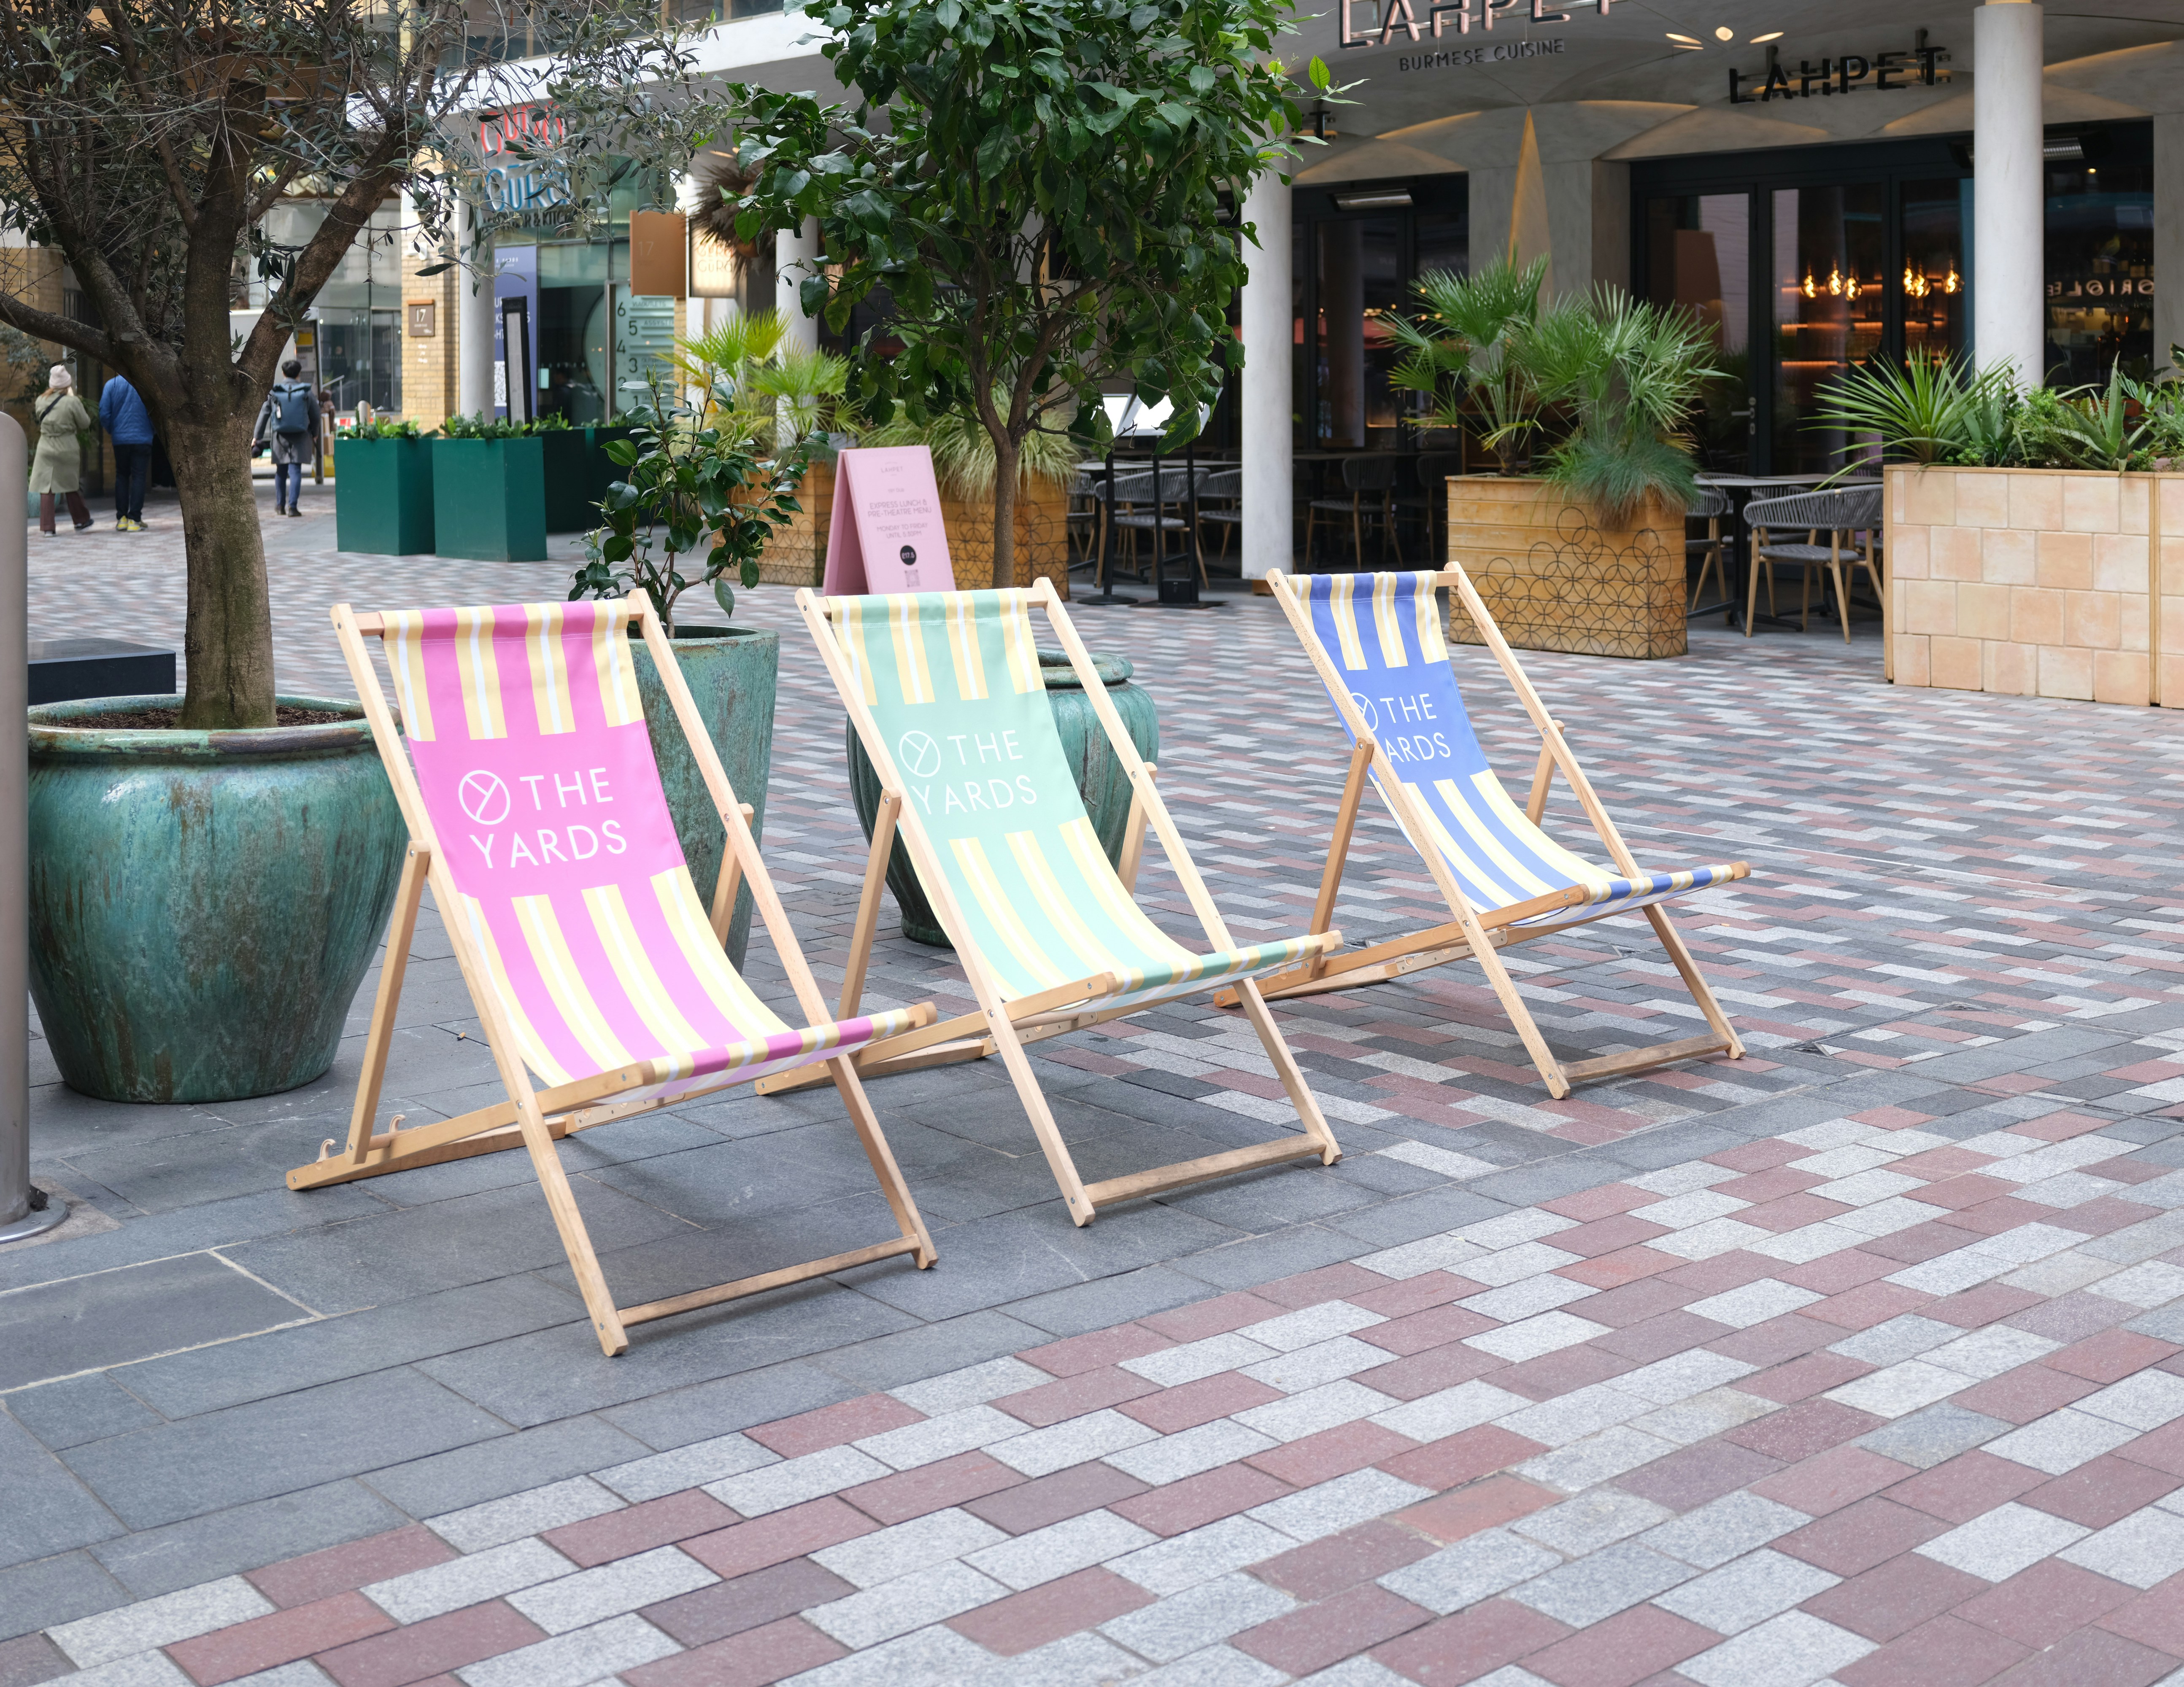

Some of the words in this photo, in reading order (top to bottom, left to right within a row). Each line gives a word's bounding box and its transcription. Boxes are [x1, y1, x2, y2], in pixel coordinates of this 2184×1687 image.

[1400, 49, 1484, 71] BURMESE
[1494, 38, 1564, 60] CUISINE
[1729, 46, 1946, 104] LAHPET
[638, 241, 654, 256] 17
[416, 308, 426, 323] 17
[617, 302, 626, 317] 6
[629, 320, 638, 336] 5
[616, 340, 626, 354] 4
[629, 357, 638, 373] 3
[618, 377, 627, 392] 2
[869, 500, 898, 509] EXPRESS
[899, 499, 921, 507] LUNCH
[868, 508, 912, 518] PRE-THEATRE
[1380, 693, 1437, 723] THE
[947, 730, 1023, 765] THE
[1385, 732, 1451, 763] ARDS
[519, 767, 614, 811] THE
[910, 774, 1037, 815] YARDS
[469, 819, 627, 869] YARDS
